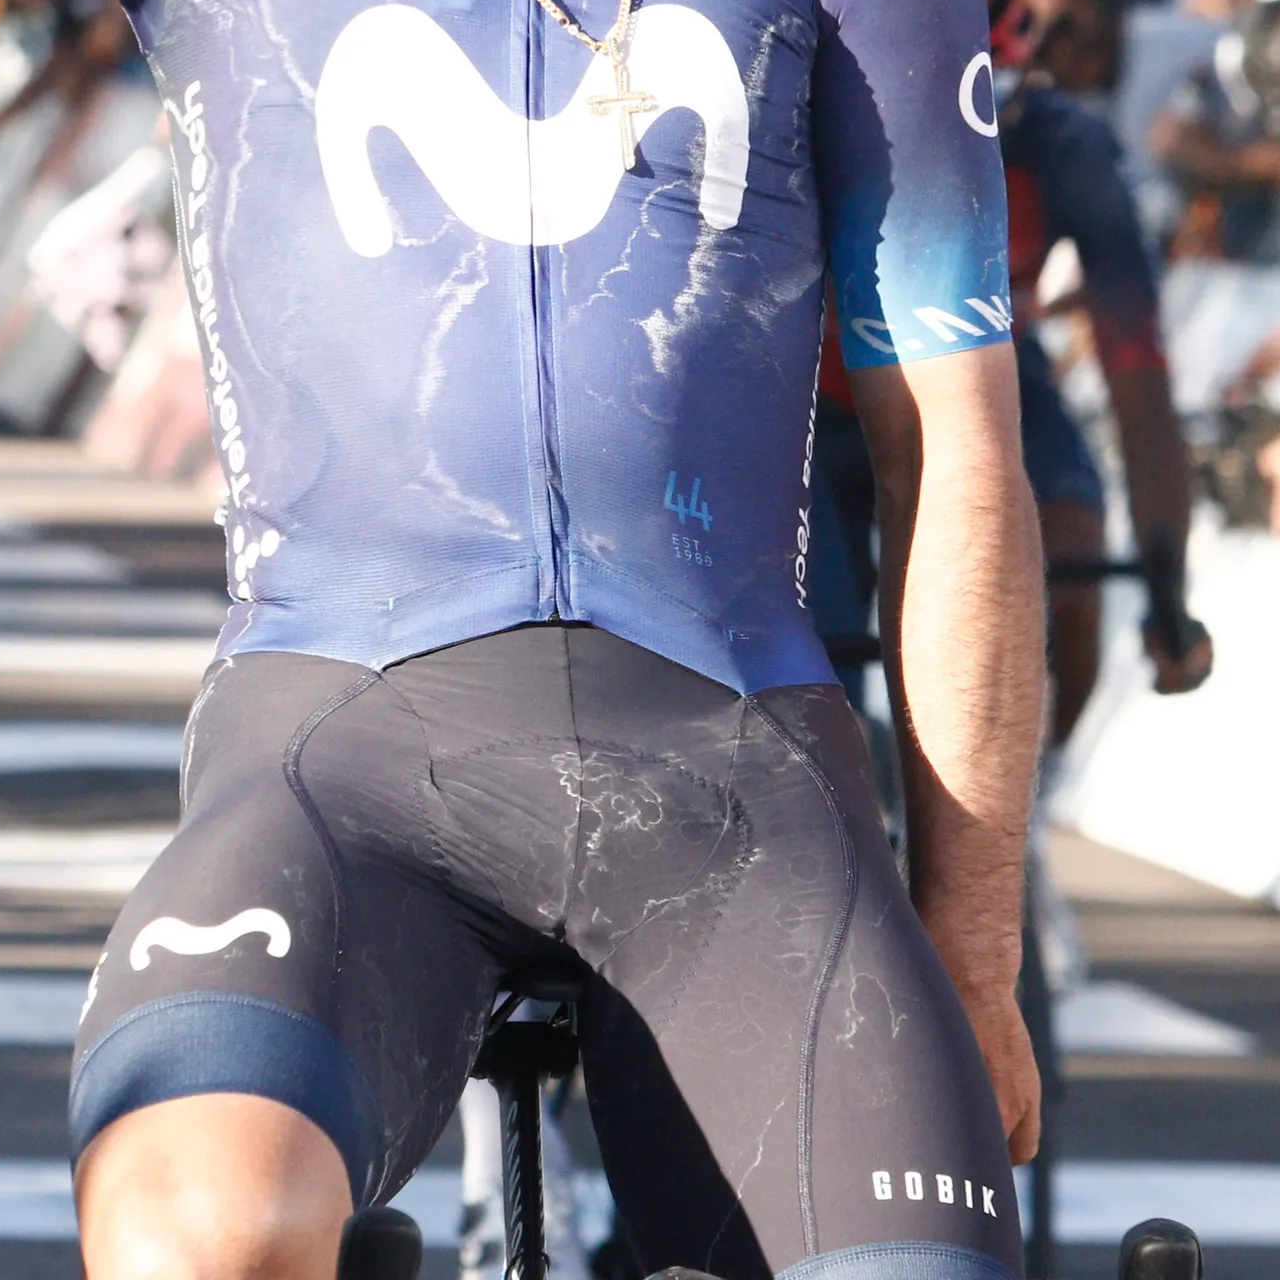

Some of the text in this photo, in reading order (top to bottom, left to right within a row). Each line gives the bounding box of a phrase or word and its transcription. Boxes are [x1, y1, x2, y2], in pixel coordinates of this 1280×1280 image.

[850, 295, 1014, 354] CAN
[664, 470, 713, 532] 44
[871, 1170, 997, 1218] GOBIK
